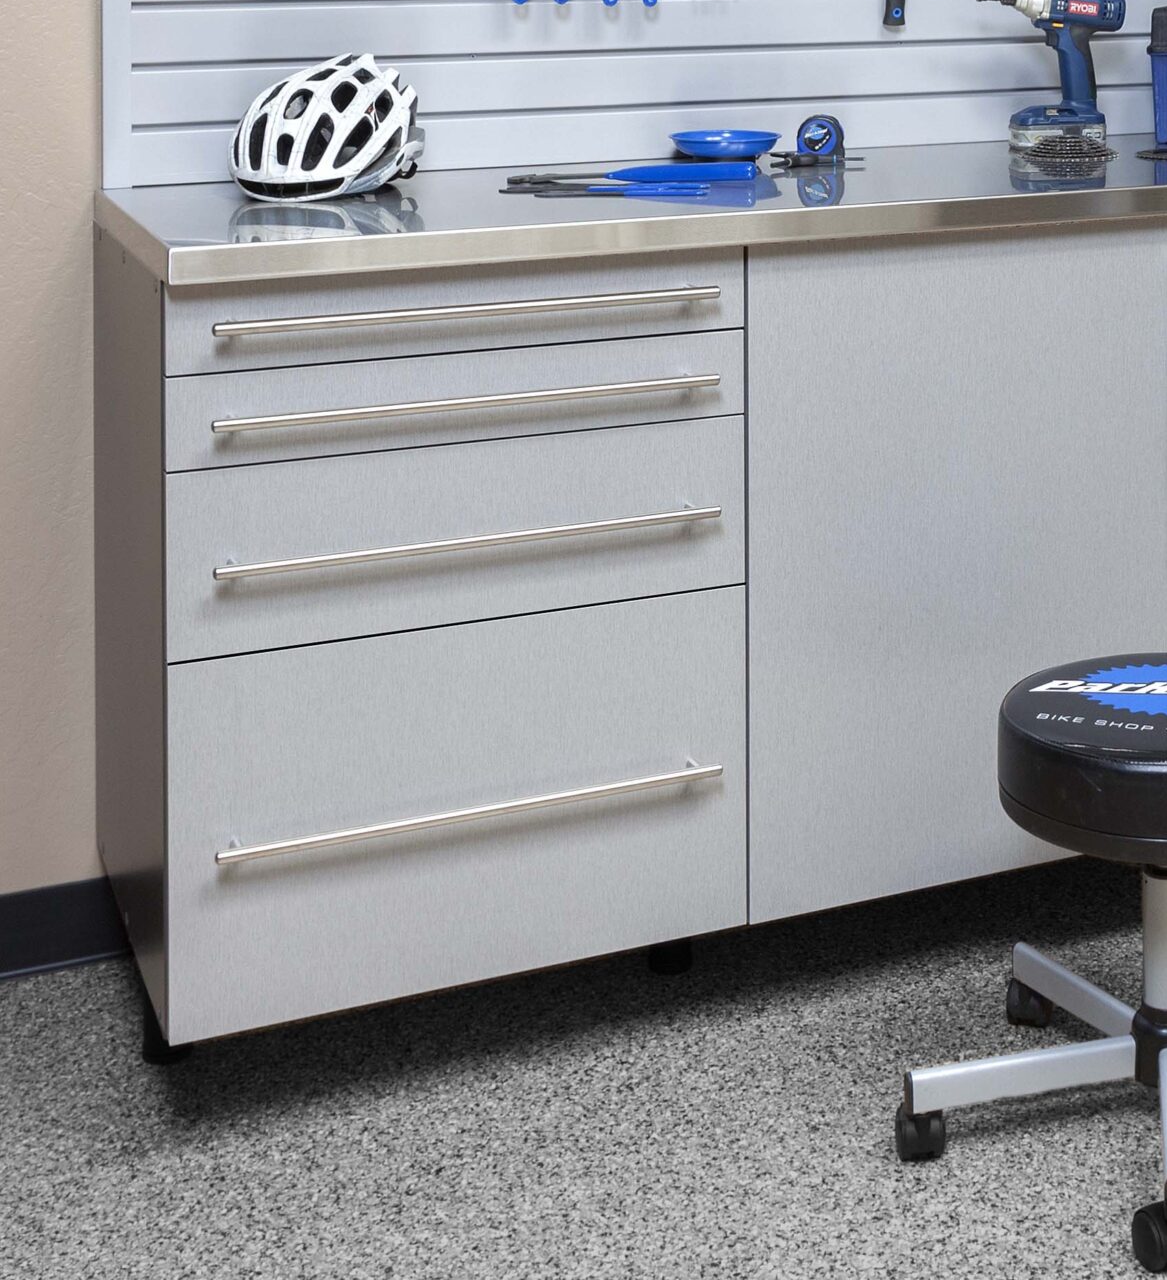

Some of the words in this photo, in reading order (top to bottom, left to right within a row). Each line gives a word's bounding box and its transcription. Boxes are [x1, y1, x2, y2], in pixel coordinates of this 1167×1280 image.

[1069, 2, 1098, 14] RYOBI
[1035, 712, 1086, 725] BIKE
[1094, 719, 1154, 732] SHOP
